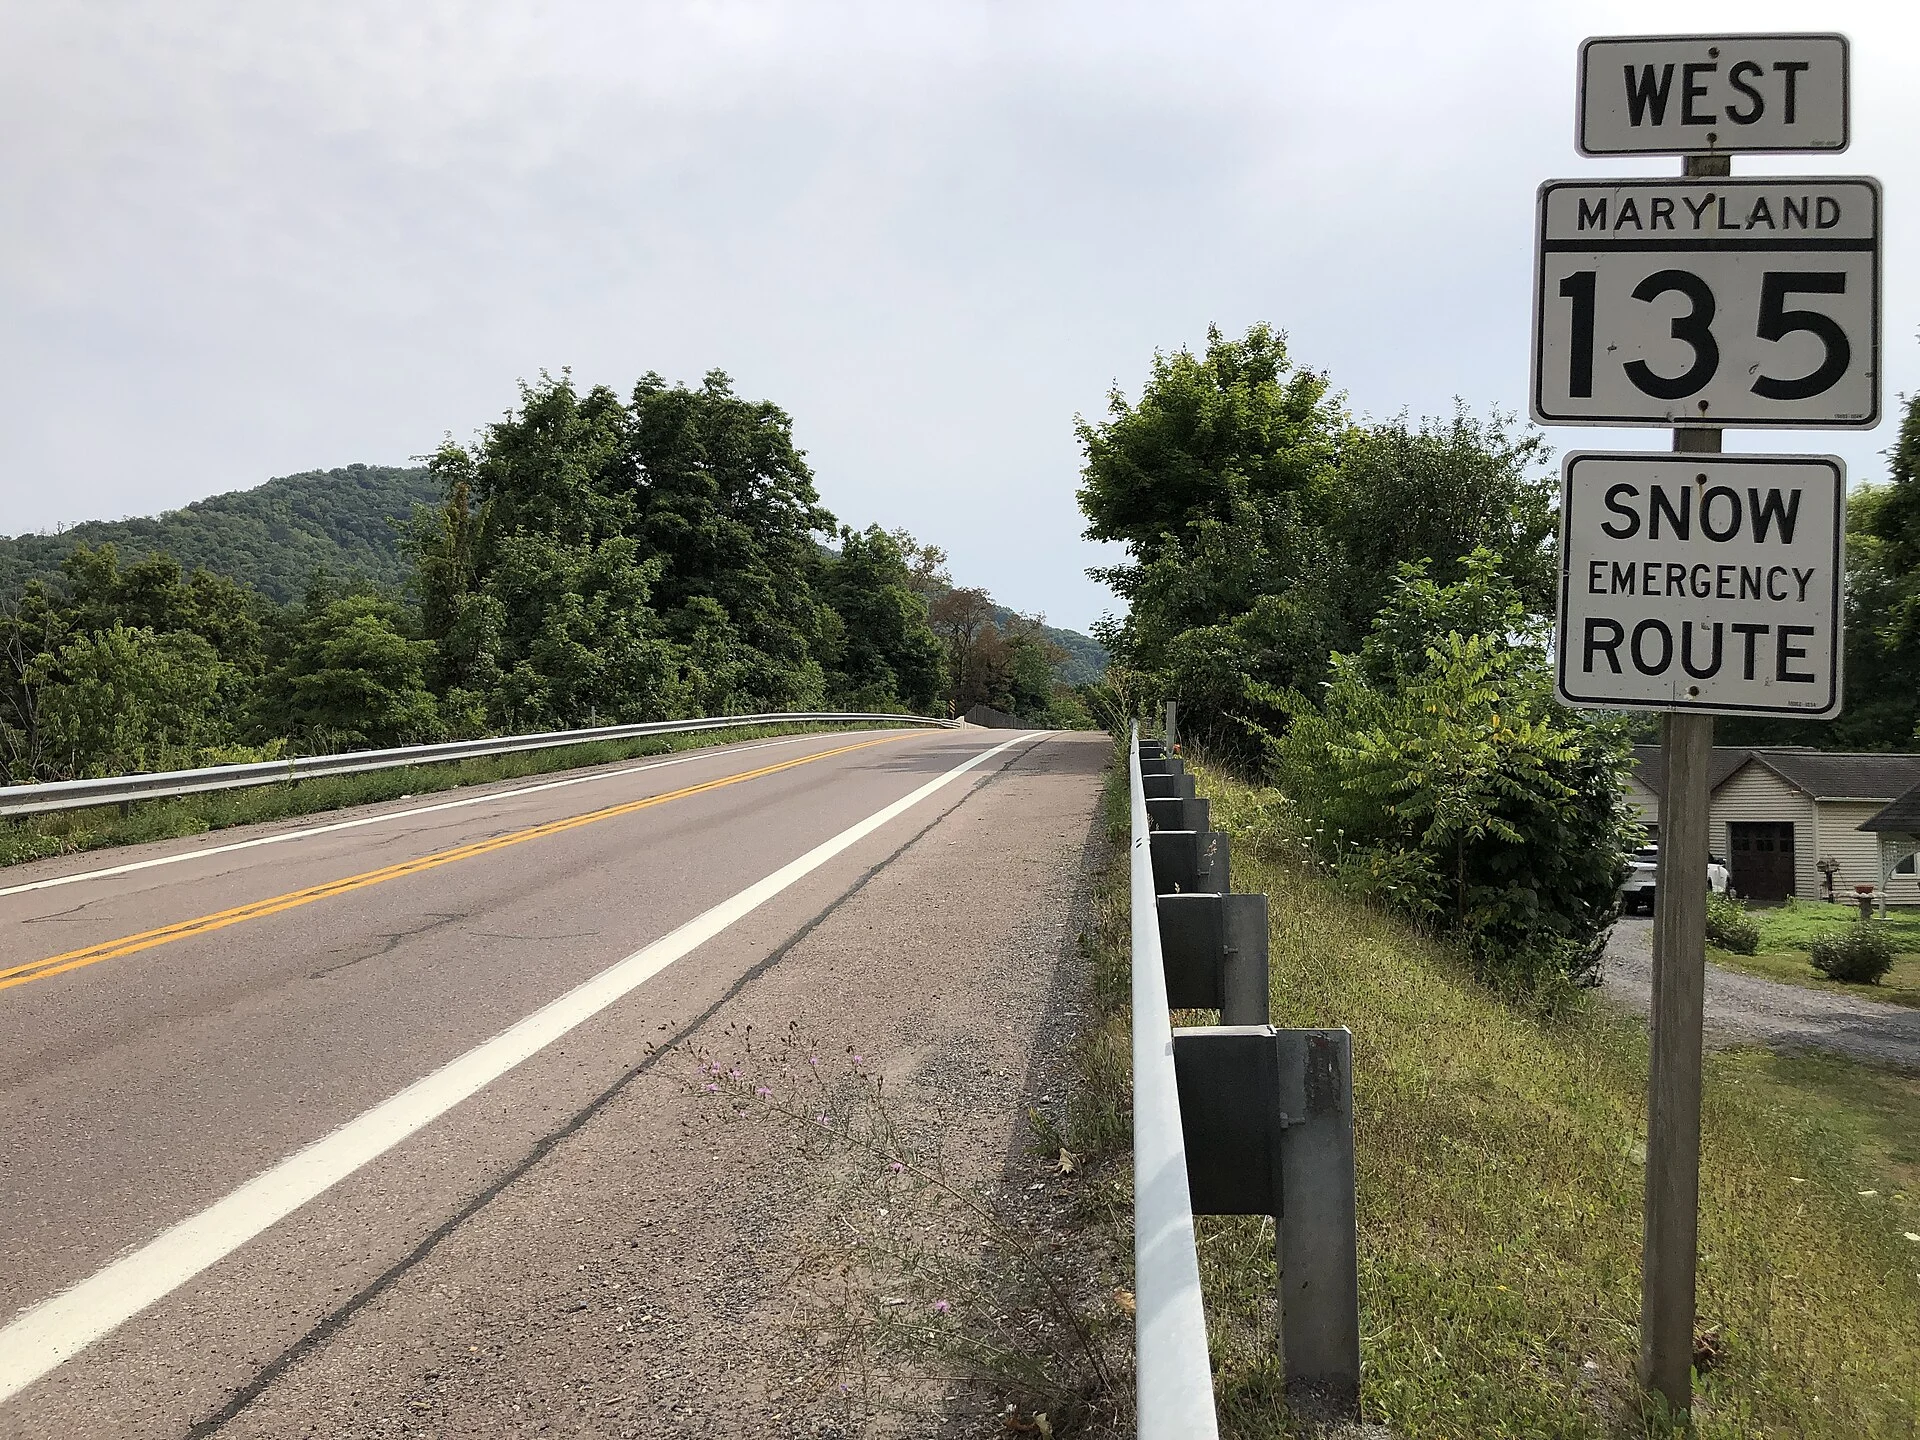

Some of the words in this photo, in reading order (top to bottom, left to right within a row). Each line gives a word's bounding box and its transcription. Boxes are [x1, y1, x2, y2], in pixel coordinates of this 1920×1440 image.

[1623, 61, 1809, 127] WEST
[1577, 196, 1840, 231] MARYLAND
[1559, 269, 1851, 400] 135
[1600, 483, 1802, 544] SNOW
[1588, 560, 1814, 602] EMERGENCY
[1582, 617, 1815, 683] ROUTE
